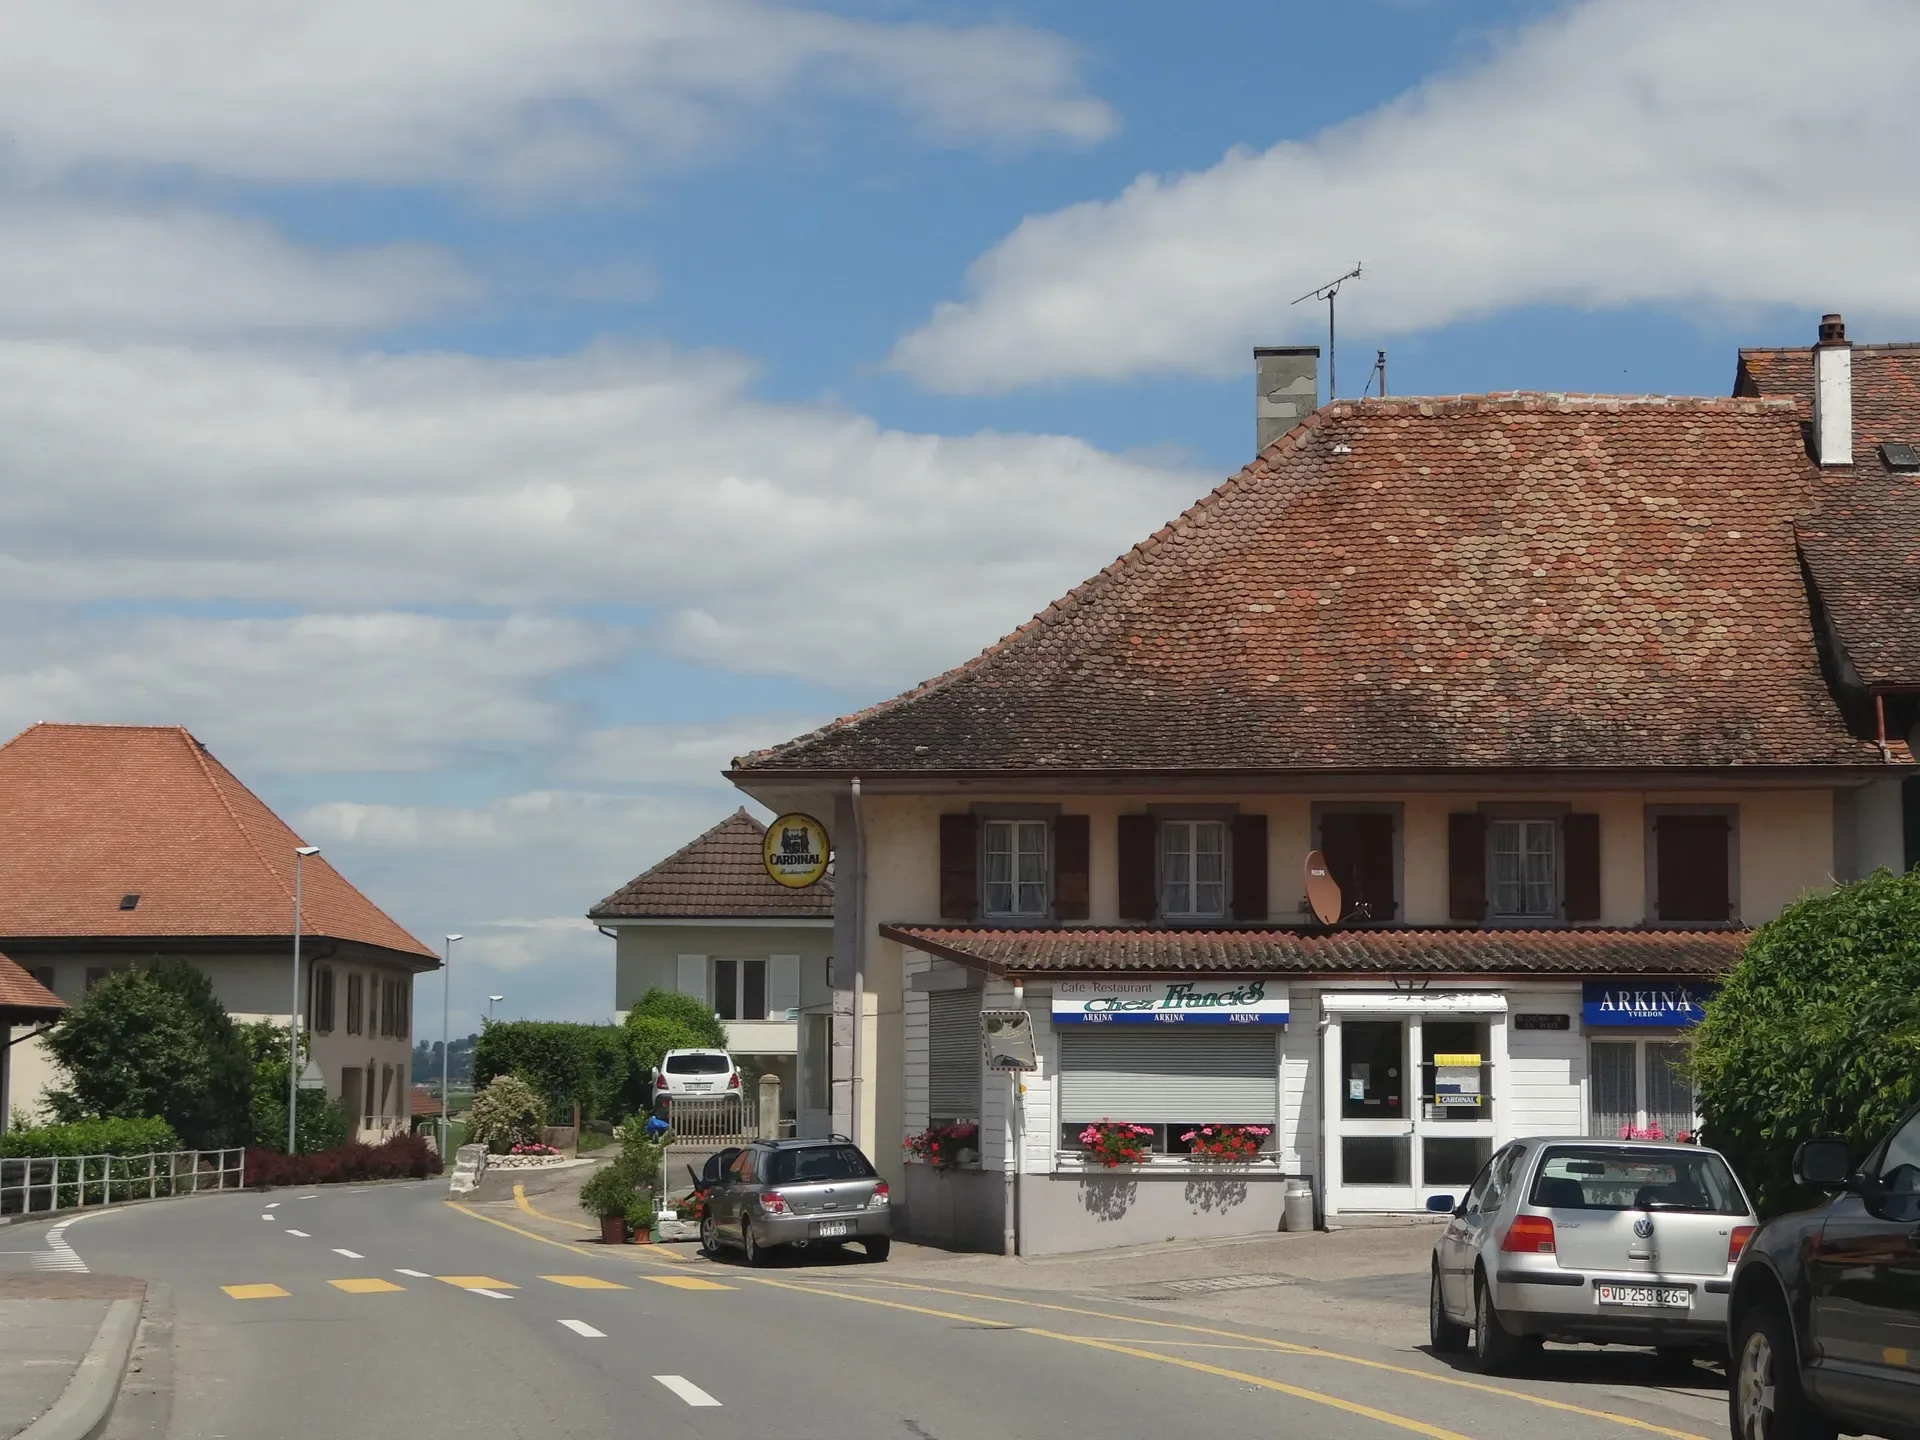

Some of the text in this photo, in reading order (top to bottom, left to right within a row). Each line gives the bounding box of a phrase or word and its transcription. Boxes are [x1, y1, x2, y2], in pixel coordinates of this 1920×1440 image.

[770, 853, 823, 866] CARDINAL
[1093, 982, 1153, 993] Restaurant
[1083, 997, 1157, 1012] Chez
[1600, 990, 1692, 1011] ARKINA
[1083, 1013, 1113, 1021] ARKINA
[1154, 1013, 1184, 1021] ARKINA
[1229, 1013, 1259, 1021] ARKINA
